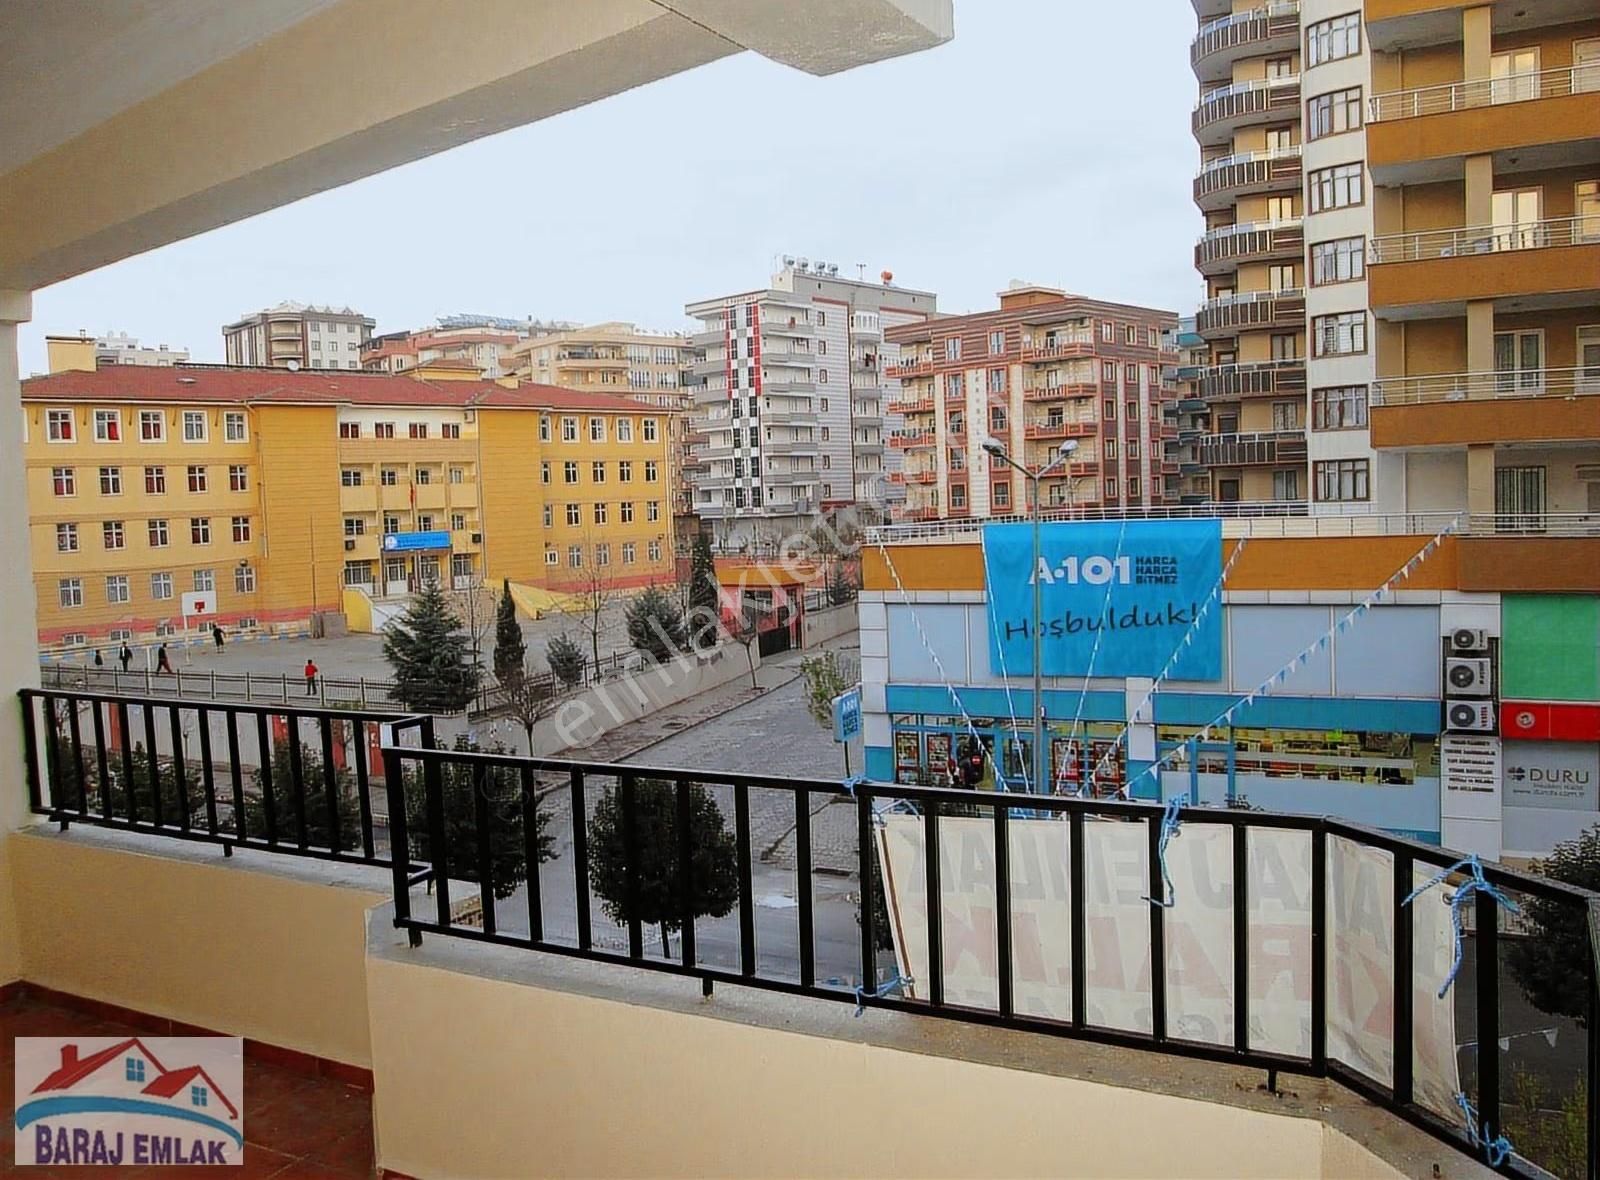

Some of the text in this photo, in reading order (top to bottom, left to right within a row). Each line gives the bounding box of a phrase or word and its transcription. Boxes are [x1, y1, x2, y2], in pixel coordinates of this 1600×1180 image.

[1136, 556, 1178, 565] HARCA
[1136, 565, 1178, 575] HARCA
[1530, 768, 1589, 785] DURU
